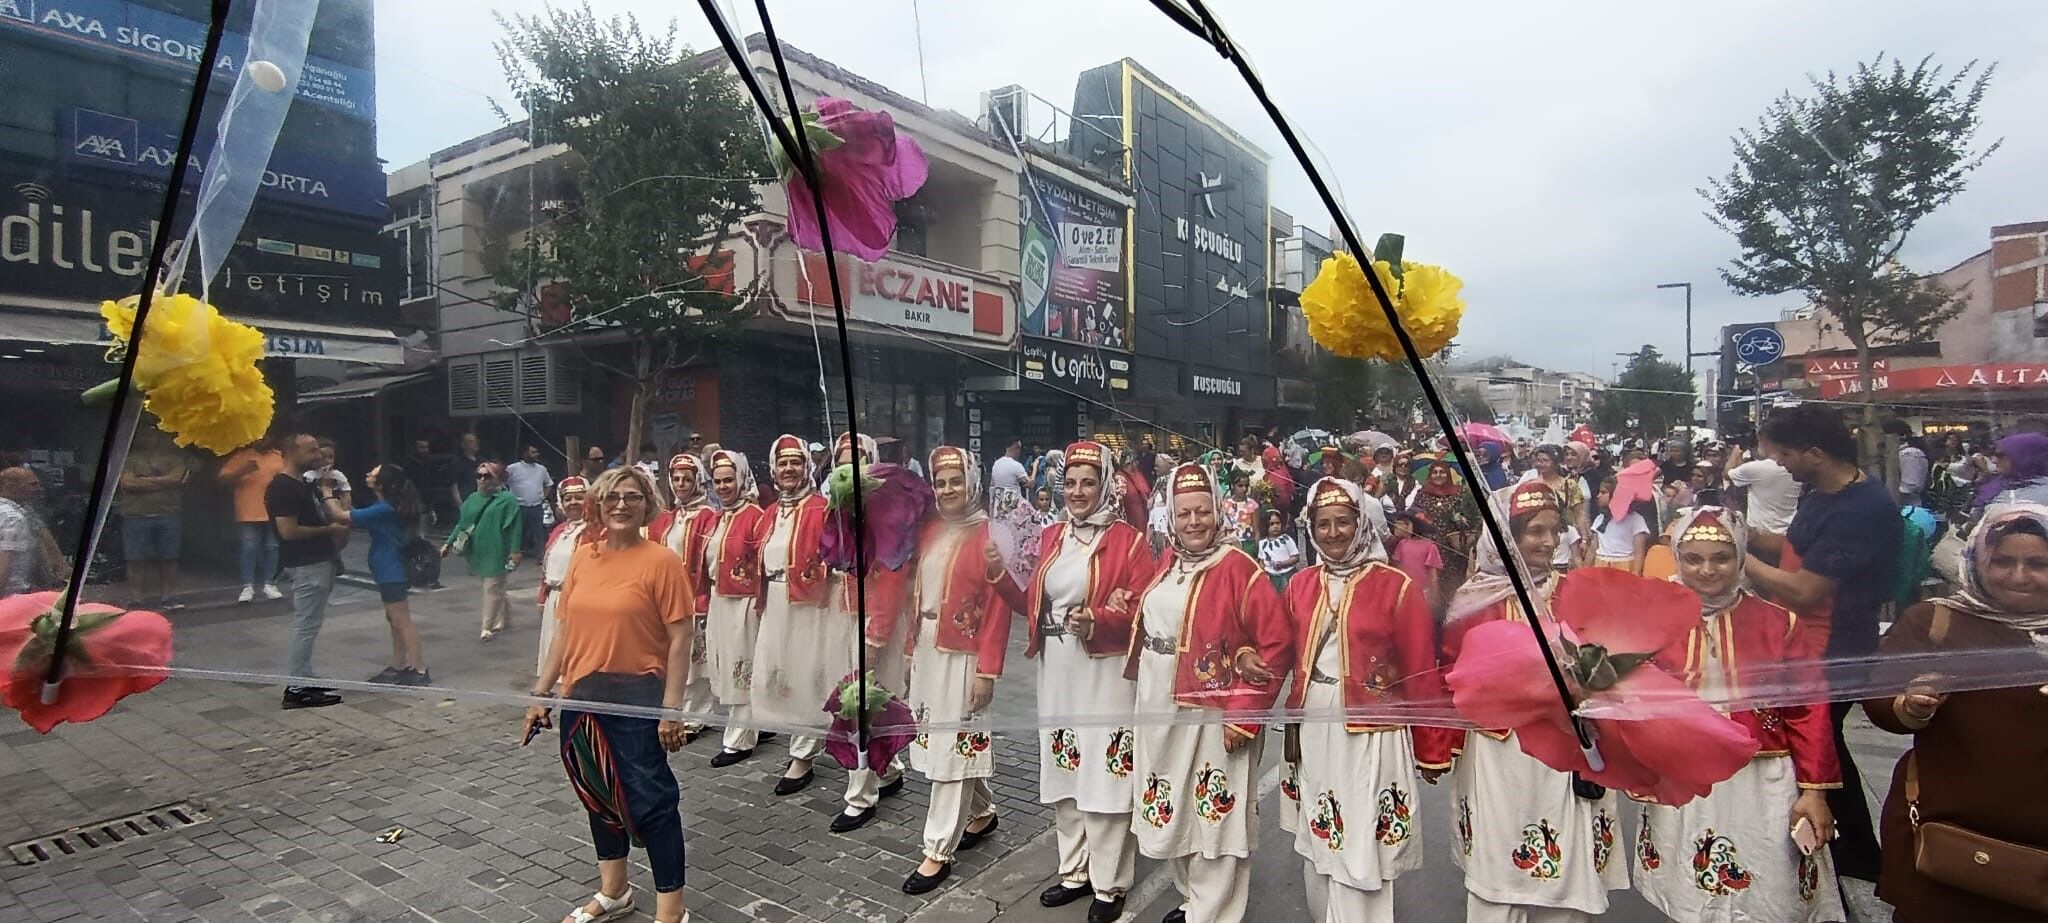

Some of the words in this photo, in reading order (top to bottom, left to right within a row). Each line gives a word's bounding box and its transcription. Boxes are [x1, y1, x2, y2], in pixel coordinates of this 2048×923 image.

[42, 9, 107, 39] AXA
[116, 27, 233, 71] SİGORA
[76, 135, 126, 158] AXA
[1081, 230, 1094, 245] ve
[224, 266, 384, 306] letişim
[857, 262, 971, 315] ECZANE
[904, 308, 931, 324] BAKIR
[1829, 359, 1886, 372] ALTN
